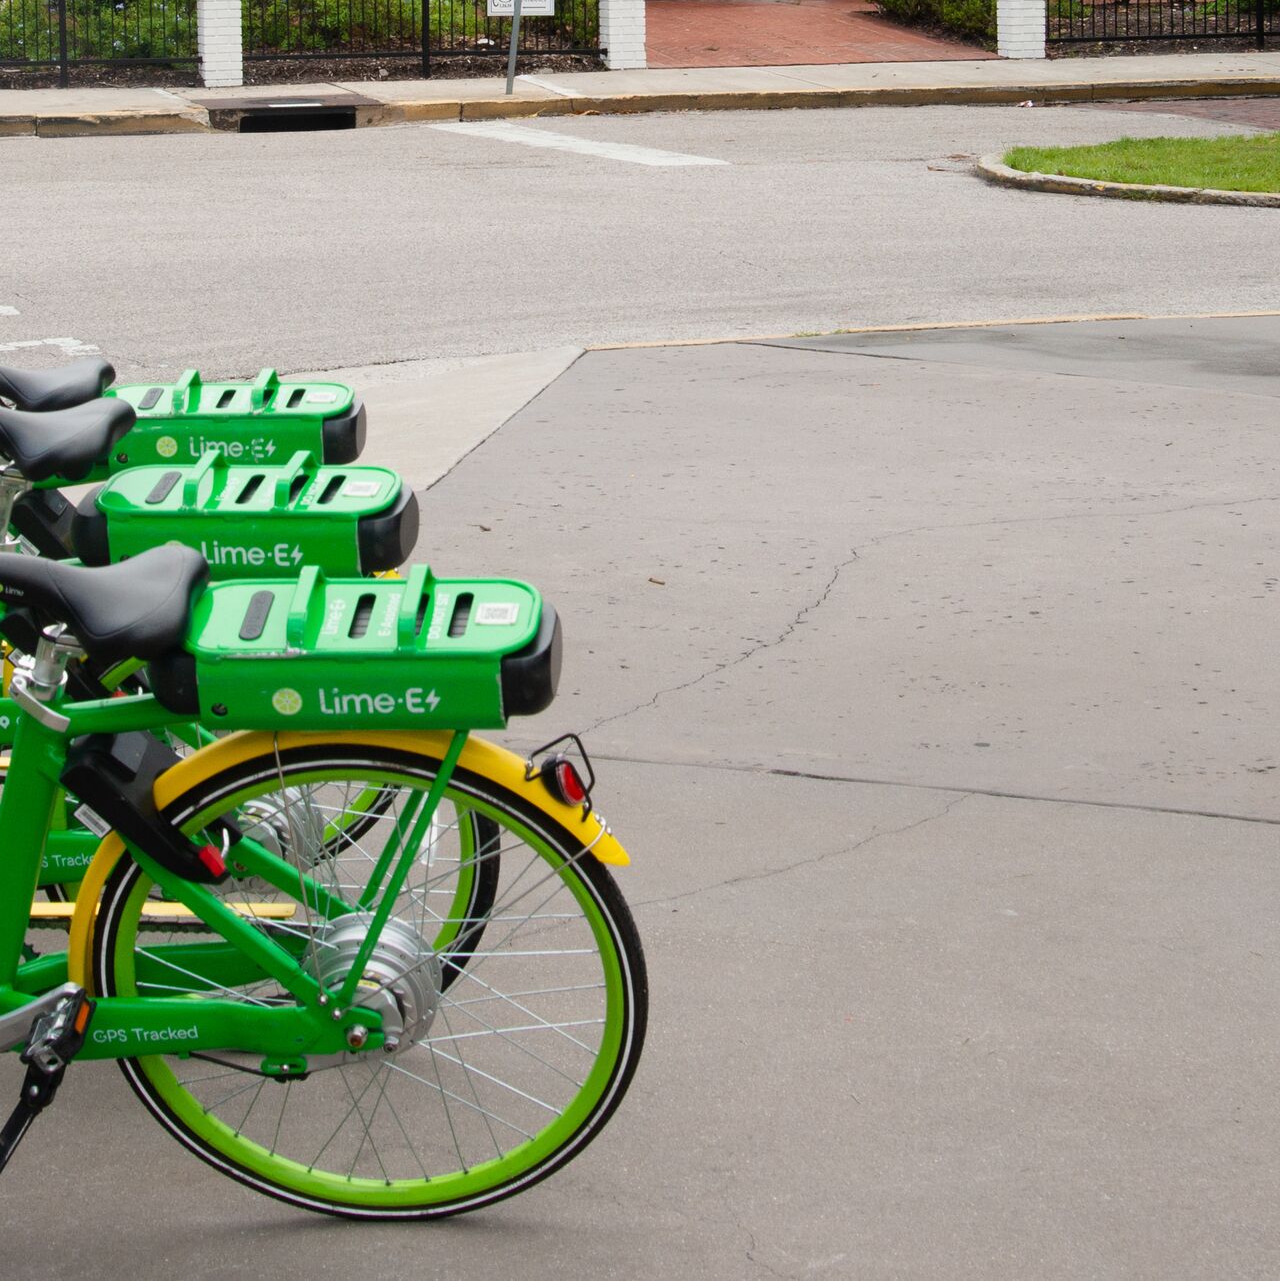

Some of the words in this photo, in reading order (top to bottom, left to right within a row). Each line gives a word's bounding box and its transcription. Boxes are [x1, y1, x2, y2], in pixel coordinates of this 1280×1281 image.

[5, 585, 25, 597] Lime
[92, 1028, 128, 1044] GPS
[131, 1025, 199, 1042] Tracked
